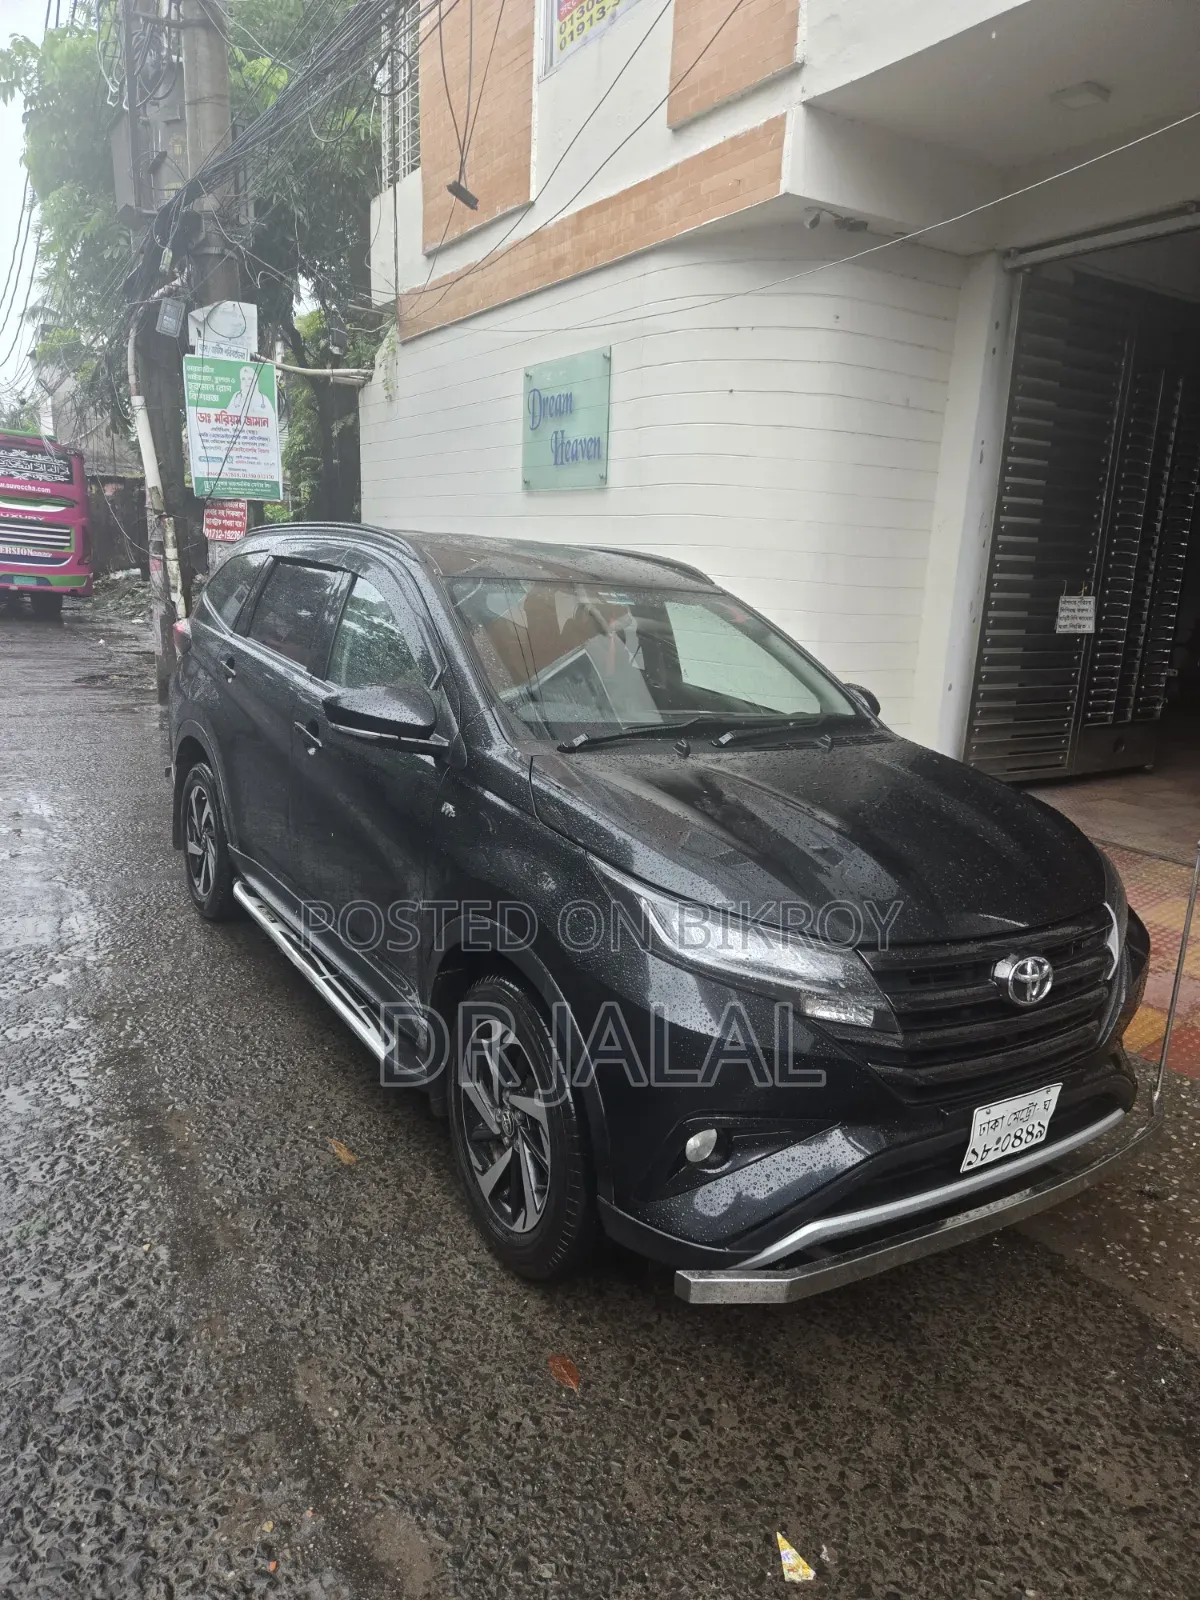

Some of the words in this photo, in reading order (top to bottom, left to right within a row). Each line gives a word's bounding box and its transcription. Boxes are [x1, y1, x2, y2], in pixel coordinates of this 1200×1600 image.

[197, 412, 212, 424] ডাঃ
[214, 410, 242, 427] মরিয়ম
[244, 415, 269, 428] জামান
[527, 388, 573, 431] Dream
[551, 430, 602, 465] Heaven
[979, 1115, 1005, 1137] ঢাকা
